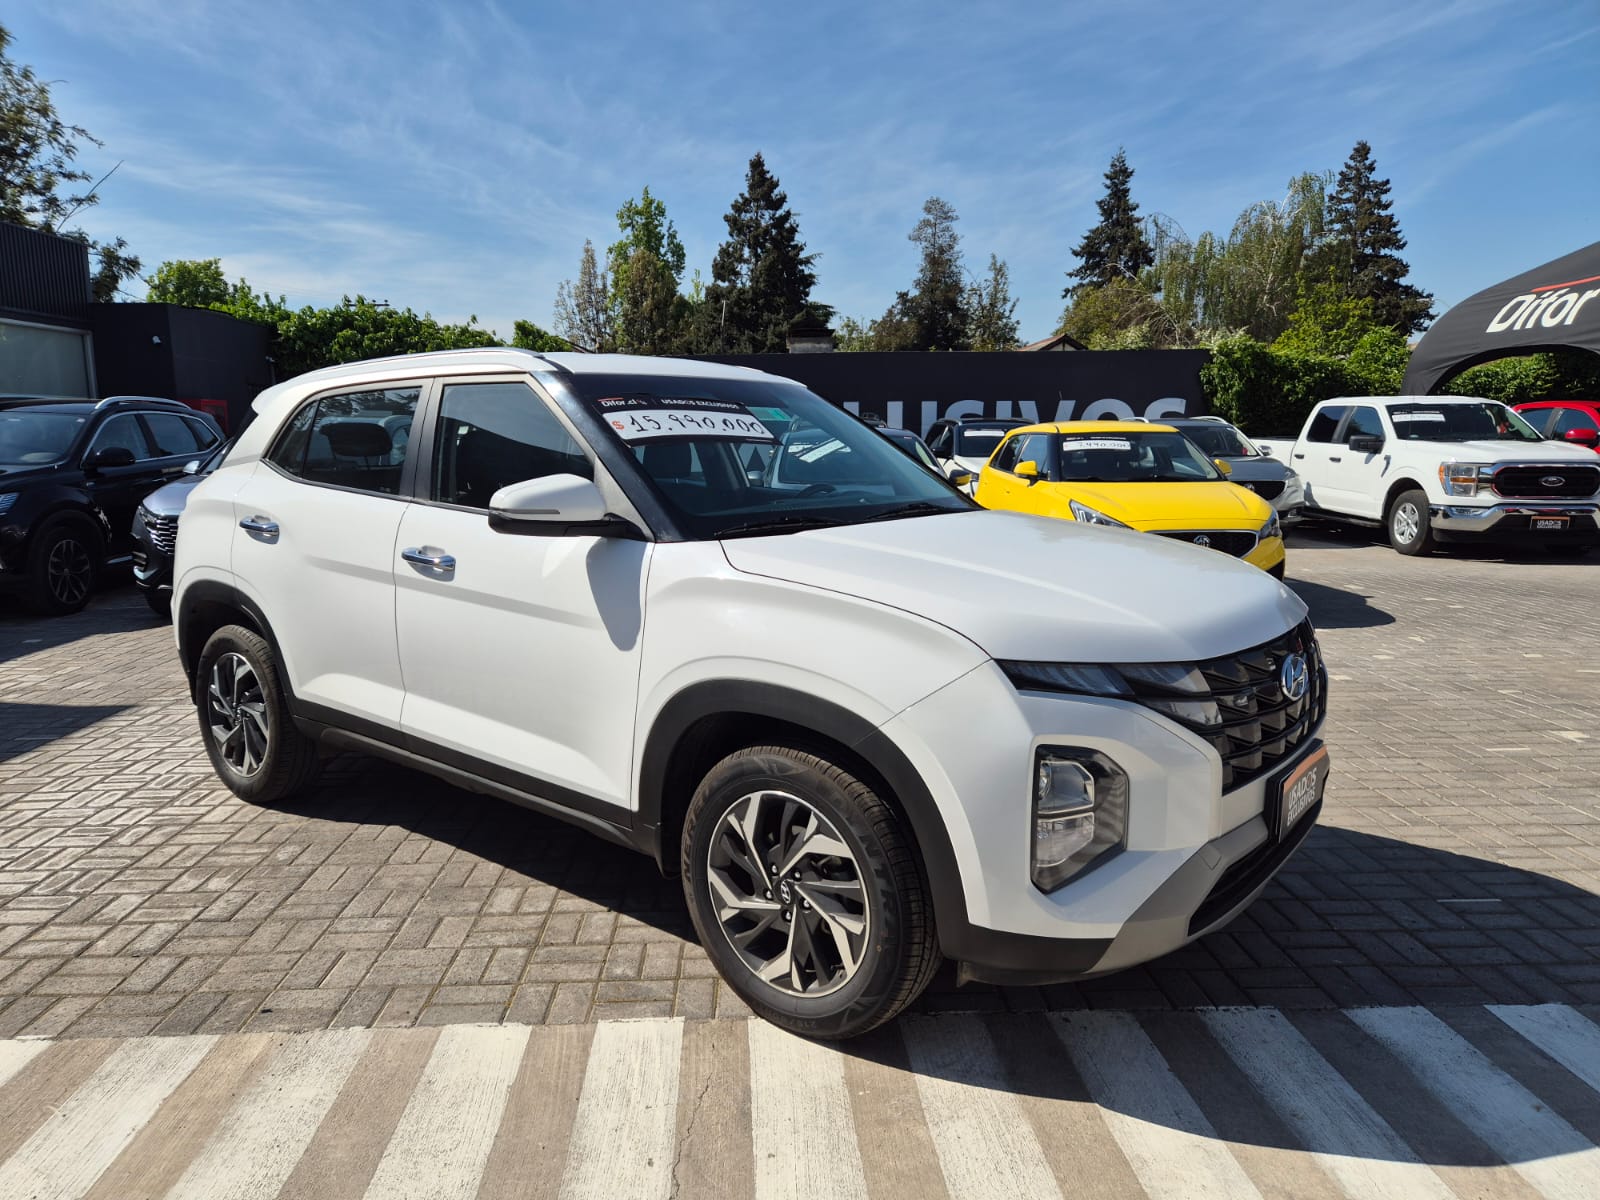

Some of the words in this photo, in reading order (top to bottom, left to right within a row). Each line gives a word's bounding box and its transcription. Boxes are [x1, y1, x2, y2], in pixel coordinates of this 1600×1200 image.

[1486, 288, 1600, 333] Difor
[629, 414, 766, 434] 15.990.000
[1286, 786, 1316, 827] EXCLUSIVOS
[1288, 767, 1318, 811] USADOS
